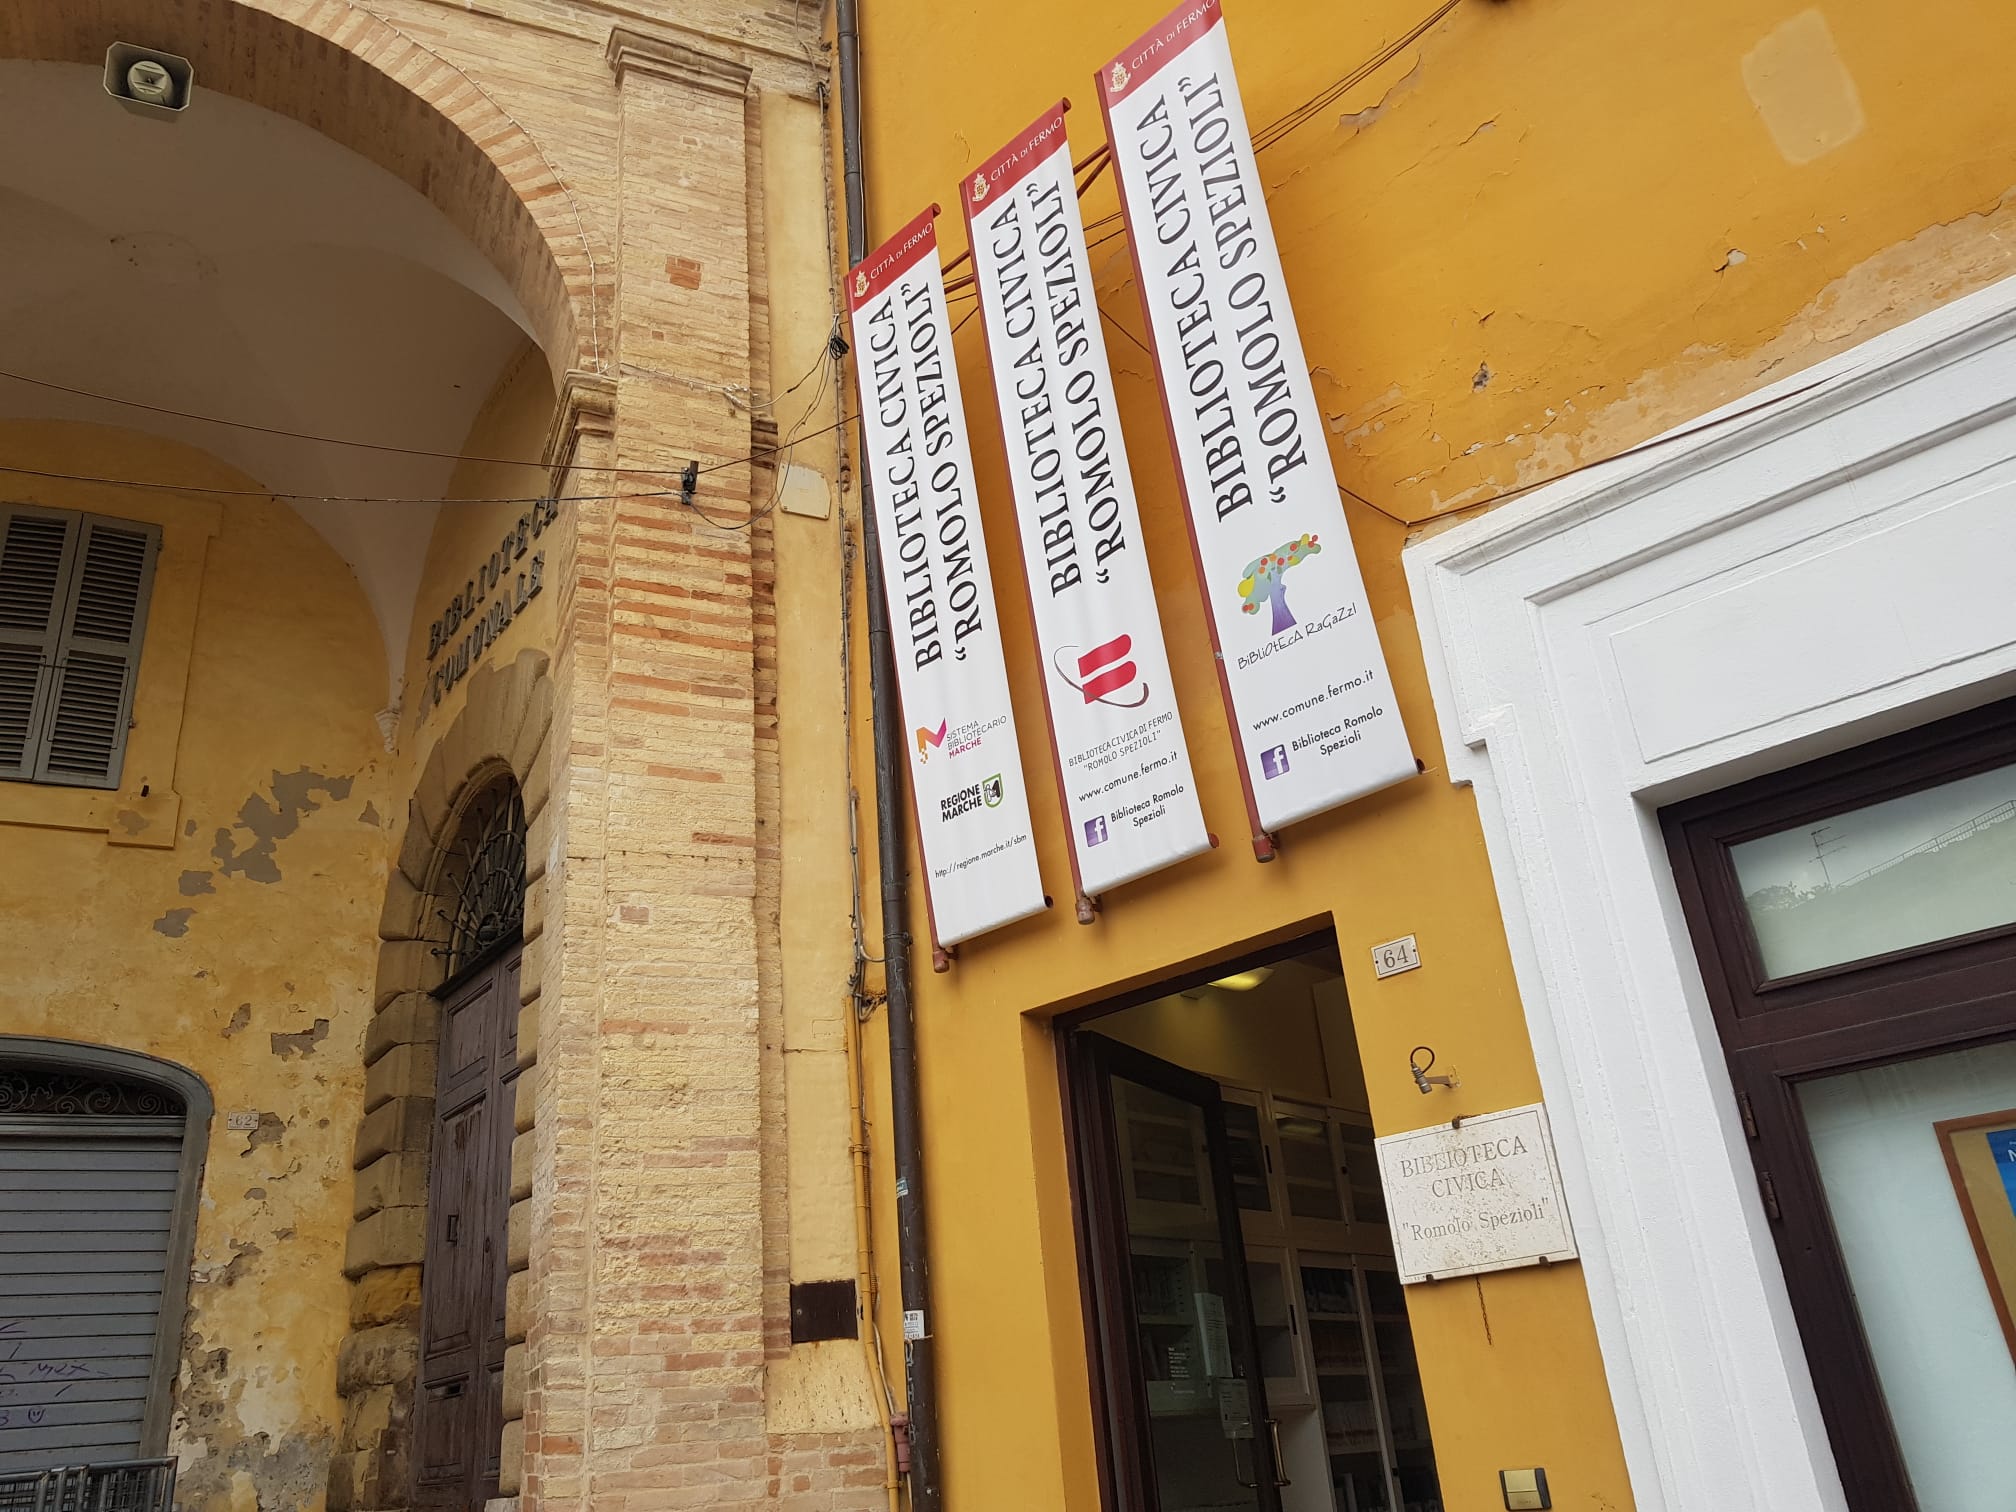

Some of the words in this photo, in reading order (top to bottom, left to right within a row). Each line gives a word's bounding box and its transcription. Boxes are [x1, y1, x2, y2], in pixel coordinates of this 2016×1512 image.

[1131, 38, 1164, 70] CITTÀ
[1166, 31, 1176, 43] DI
[1176, 0, 1216, 34] FERMO
[990, 153, 1019, 181] CITTÀ
[1020, 148, 1028, 159] DI
[1029, 116, 1063, 151] FERMO
[1136, 93, 1191, 245] CIVICA
[870, 254, 895, 279] CITTÀ
[903, 222, 933, 253] FERMO
[990, 197, 1036, 340] CIVICA
[869, 295, 907, 428] CIVICA
[1167, 239, 1253, 523] BIBLIOTECA
[1013, 336, 1082, 598] BIBLIOTECA
[887, 427, 943, 672] BIBLIOTECA
[1252, 669, 1374, 732] www.comune.fermo.it
[947, 720, 979, 741] SISTEMA
[947, 715, 1007, 750] BIBLIOTECARIO
[949, 737, 982, 759] MARCHE
[1069, 740, 1112, 767] BIBLIOTECA
[1111, 730, 1138, 747] CIVICA
[1138, 725, 1147, 734] DI
[1148, 711, 1173, 730] FERMO
[1291, 723, 1342, 752] Biblioteca
[1343, 704, 1383, 730] Romolo
[1319, 730, 1362, 756] Spezioli
[940, 784, 981, 811] REGIONE
[1078, 751, 1178, 802] www.comune.fermo.it
[942, 796, 983, 823] MARCHE
[1110, 800, 1151, 823] Biblioteca
[1152, 783, 1184, 804] Romolo
[1133, 804, 1166, 828] Spezioli
[1383, 945, 1409, 970] 64
[236, 1115, 252, 1126] 62
[1401, 1136, 1528, 1178] BIBLIOTECA
[1432, 1168, 1505, 1198] CIVICA
